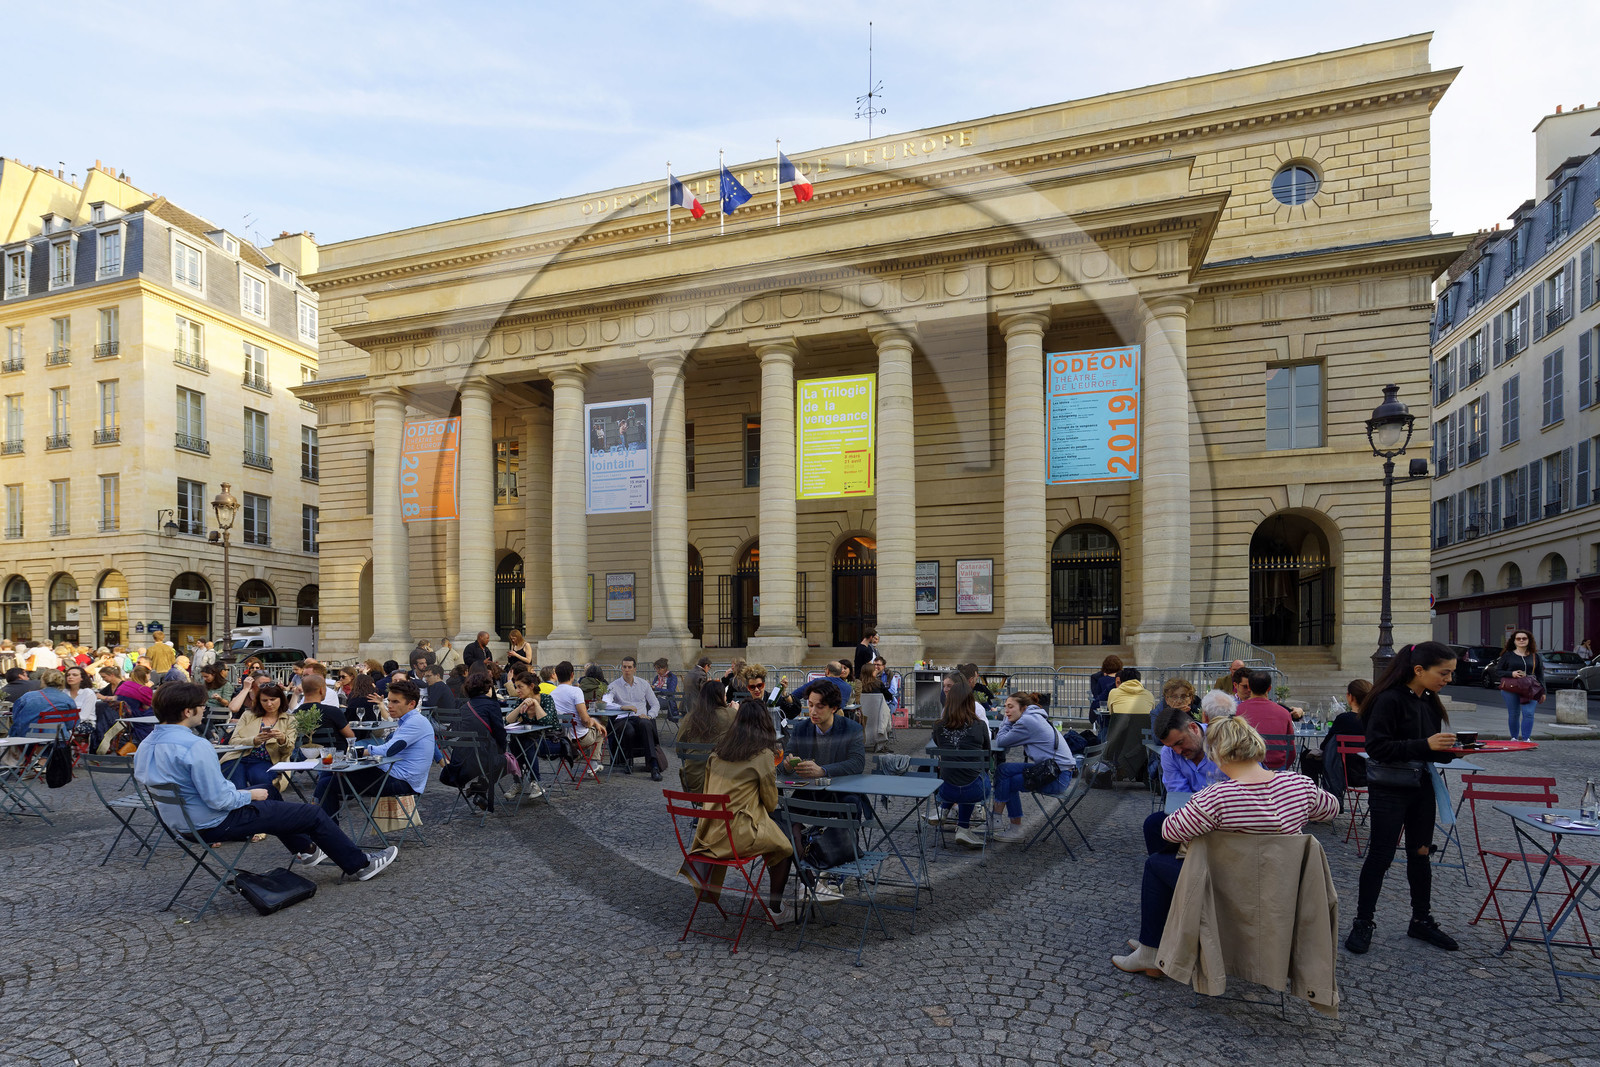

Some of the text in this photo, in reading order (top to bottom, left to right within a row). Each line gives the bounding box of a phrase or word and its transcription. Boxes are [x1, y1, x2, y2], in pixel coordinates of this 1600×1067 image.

[799, 157, 830, 176] DE
[845, 130, 974, 168] L'EUROPE
[1053, 351, 1133, 374] ODÉON
[804, 384, 867, 400] La Trilogie
[1055, 379, 1118, 391] DE L'EUROPE
[804, 400, 836, 413] de la
[804, 411, 868, 426] vengeance
[407, 421, 456, 437] ODÉON
[1107, 394, 1136, 473] 2019
[592, 444, 637, 458] Le Pays
[591, 457, 635, 471] lointain
[402, 456, 420, 517] 2018
